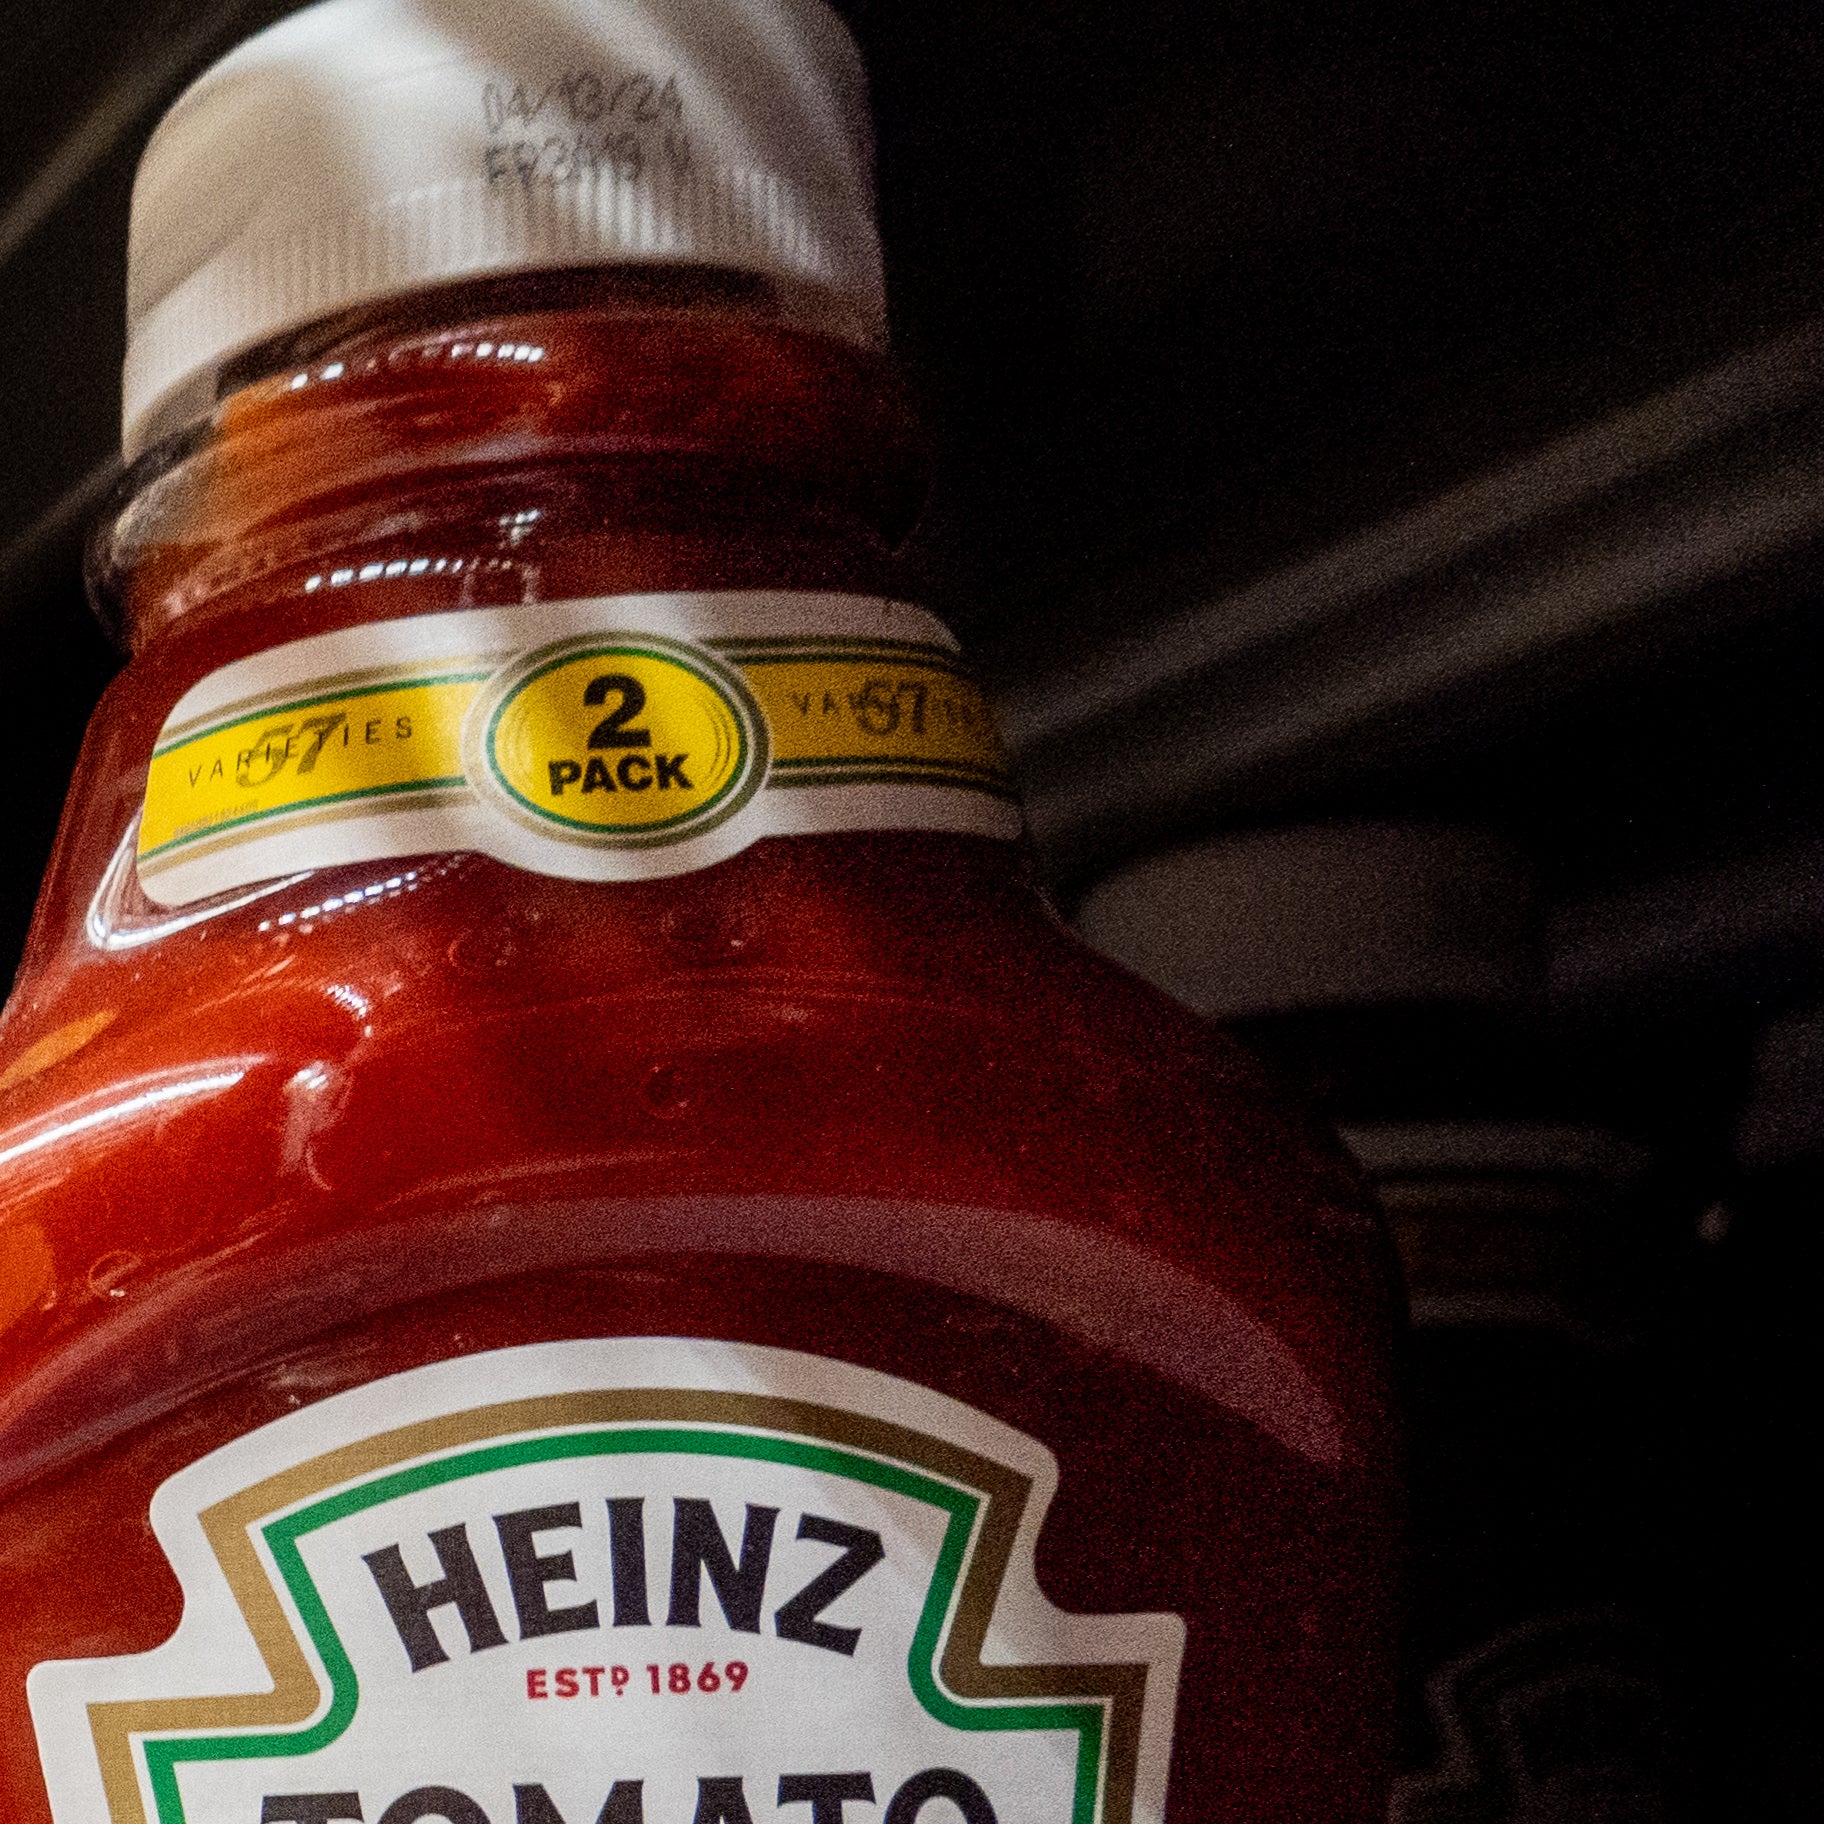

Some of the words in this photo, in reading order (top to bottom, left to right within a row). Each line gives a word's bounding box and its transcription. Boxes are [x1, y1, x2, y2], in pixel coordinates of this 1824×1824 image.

[235, 711, 348, 789] 57
[583, 673, 652, 751] 2
[548, 754, 694, 796] PACK
[361, 1496, 886, 1673] HEINZ
[646, 1661, 749, 1695] 1869
